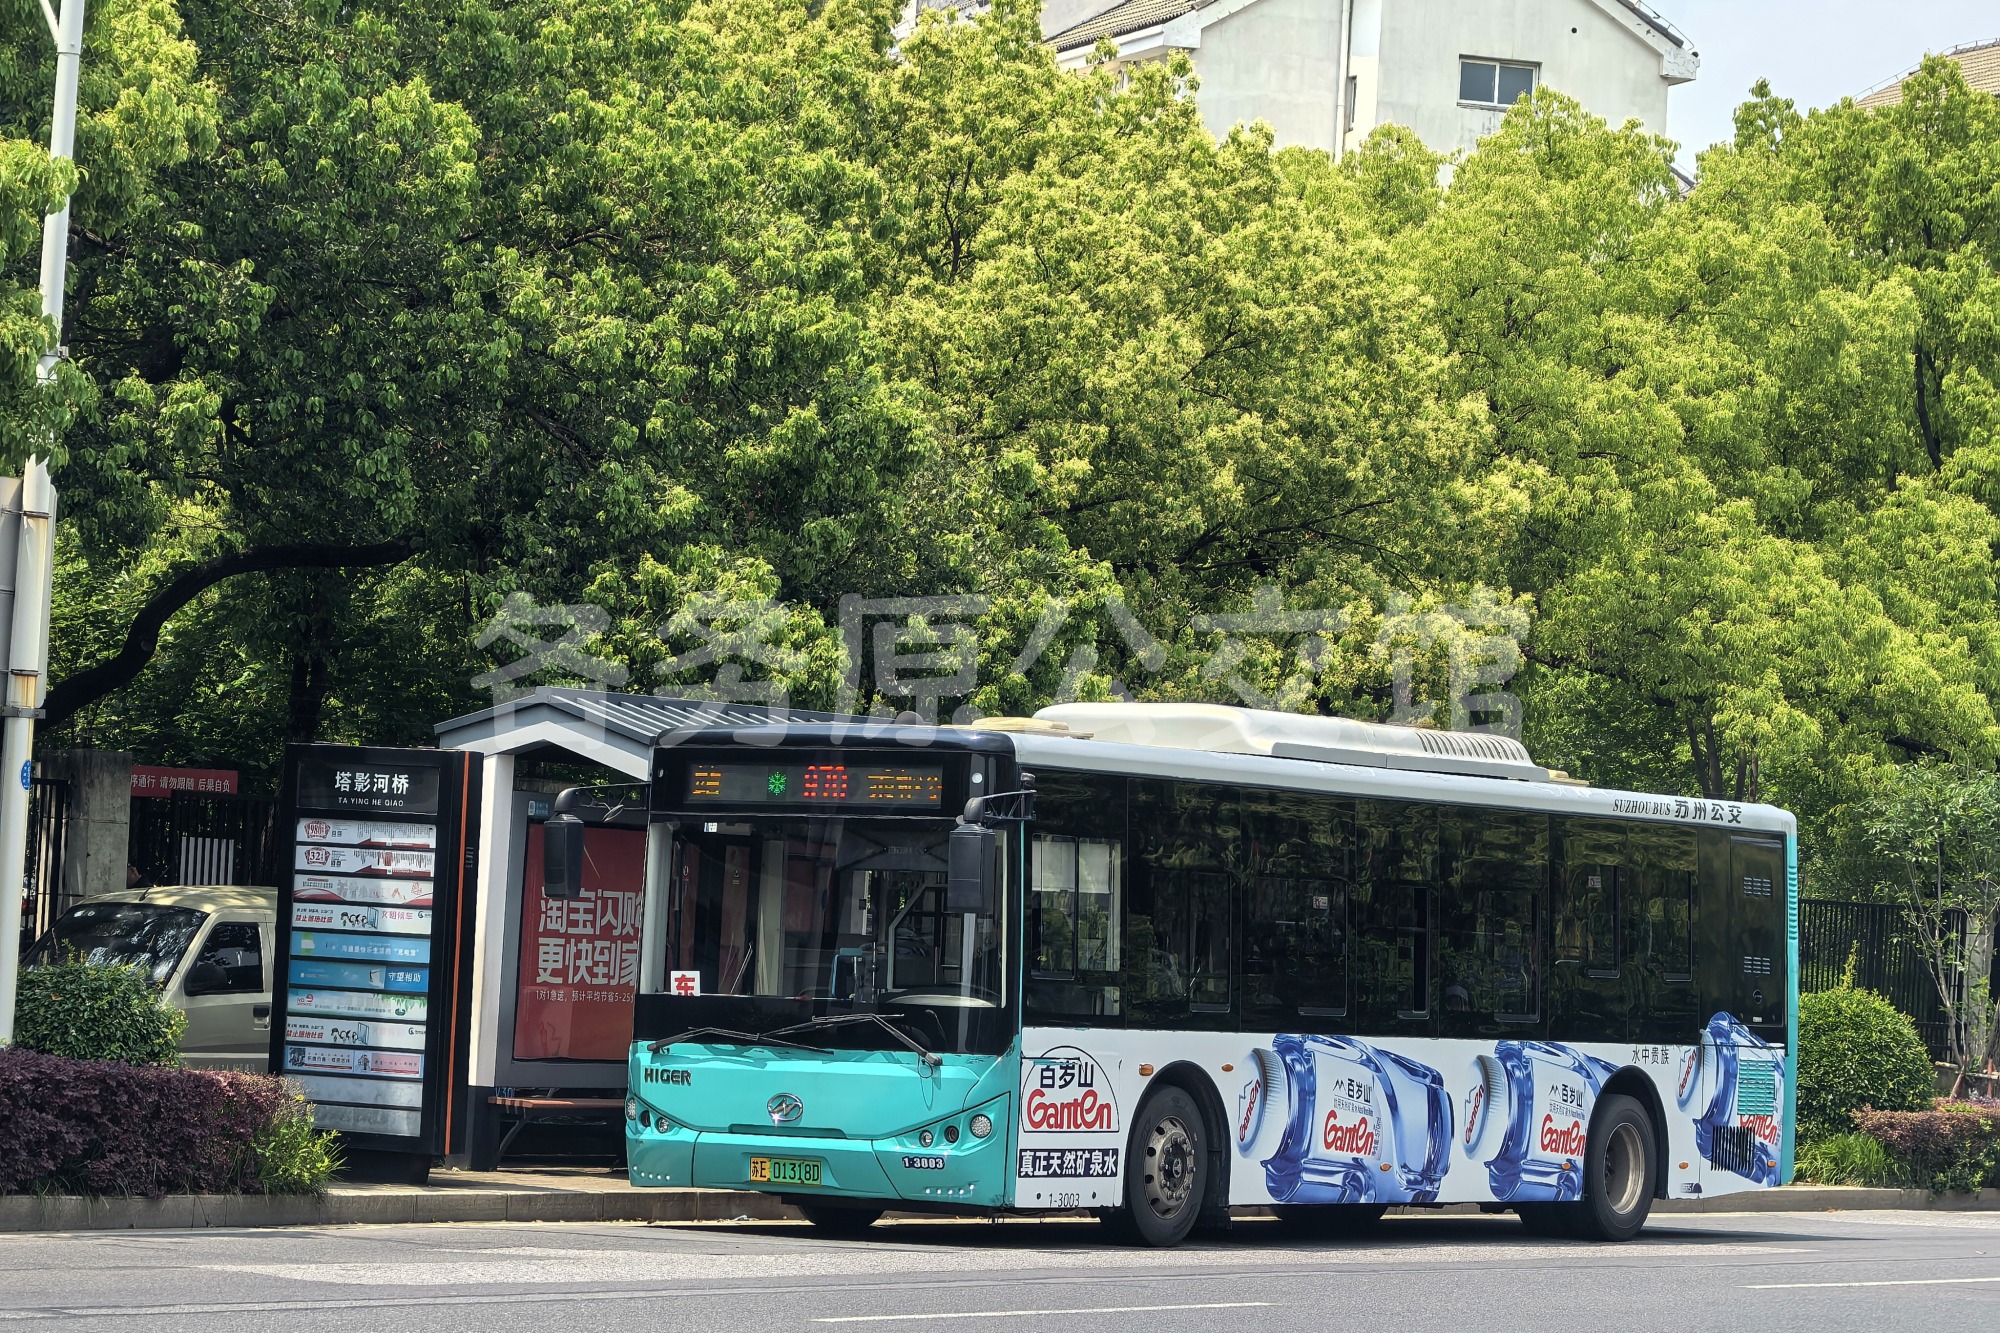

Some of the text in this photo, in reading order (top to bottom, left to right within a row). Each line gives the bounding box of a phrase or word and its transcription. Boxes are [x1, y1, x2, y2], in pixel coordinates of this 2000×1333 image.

[198, 779, 230, 792] 后果自负
[334, 771, 409, 795] 塔影河桥
[1613, 799, 1671, 816] SUZHOU BUS
[1674, 799, 1742, 824] 苏州公交
[536, 937, 638, 987] 更快到家
[1631, 1045, 1669, 1065] 水中贵族
[644, 1067, 692, 1087] HIGER
[1347, 1078, 1371, 1103] 百岁山
[1562, 1083, 1583, 1108] 百岁山
[1027, 1089, 1111, 1129] Ganten
[1324, 1109, 1374, 1156] Ganten
[1541, 1113, 1585, 1157] Ganten
[1020, 1150, 1116, 1176] 真正天然矿泉水
[1049, 1193, 1080, 1208] 1-3003
